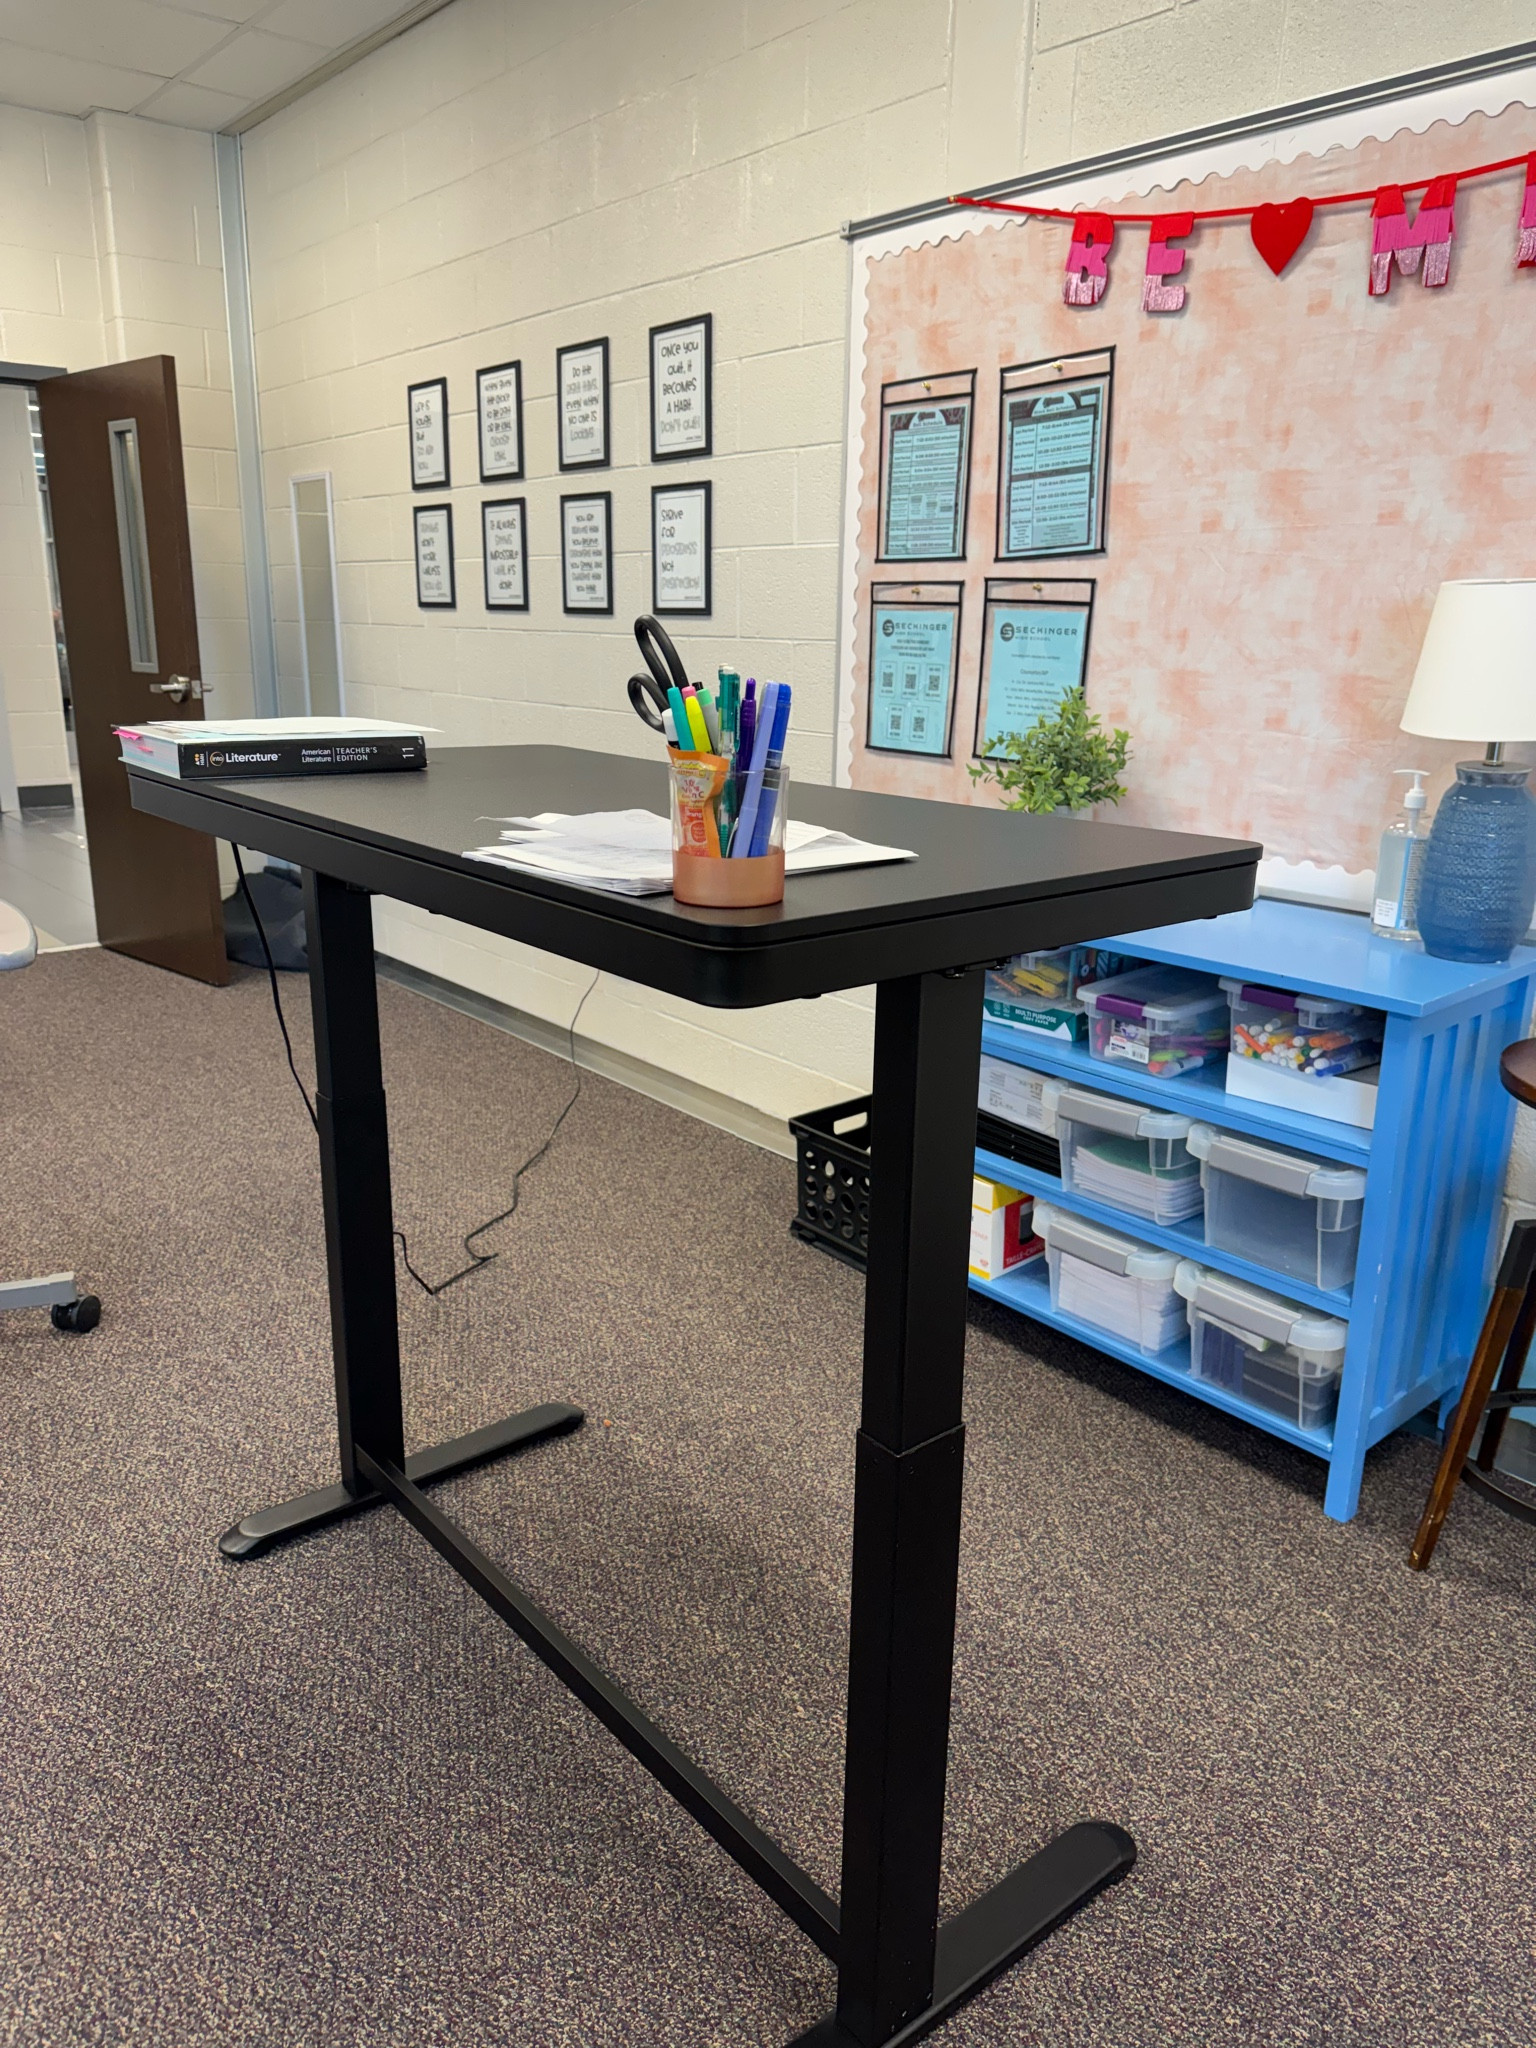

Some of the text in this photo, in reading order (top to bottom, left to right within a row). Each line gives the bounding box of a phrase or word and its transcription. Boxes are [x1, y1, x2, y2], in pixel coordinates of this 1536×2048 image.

[1063, 211, 1194, 312] BE
[301, 748, 331, 756] American
[336, 746, 378, 755] TEACHER'S
[401, 747, 415, 759] 11
[302, 755, 332, 763] Literature
[336, 754, 368, 762] EDITION
[1015, 1008, 1032, 1018] MULTI
[1032, 1011, 1057, 1024] PURPOSE
